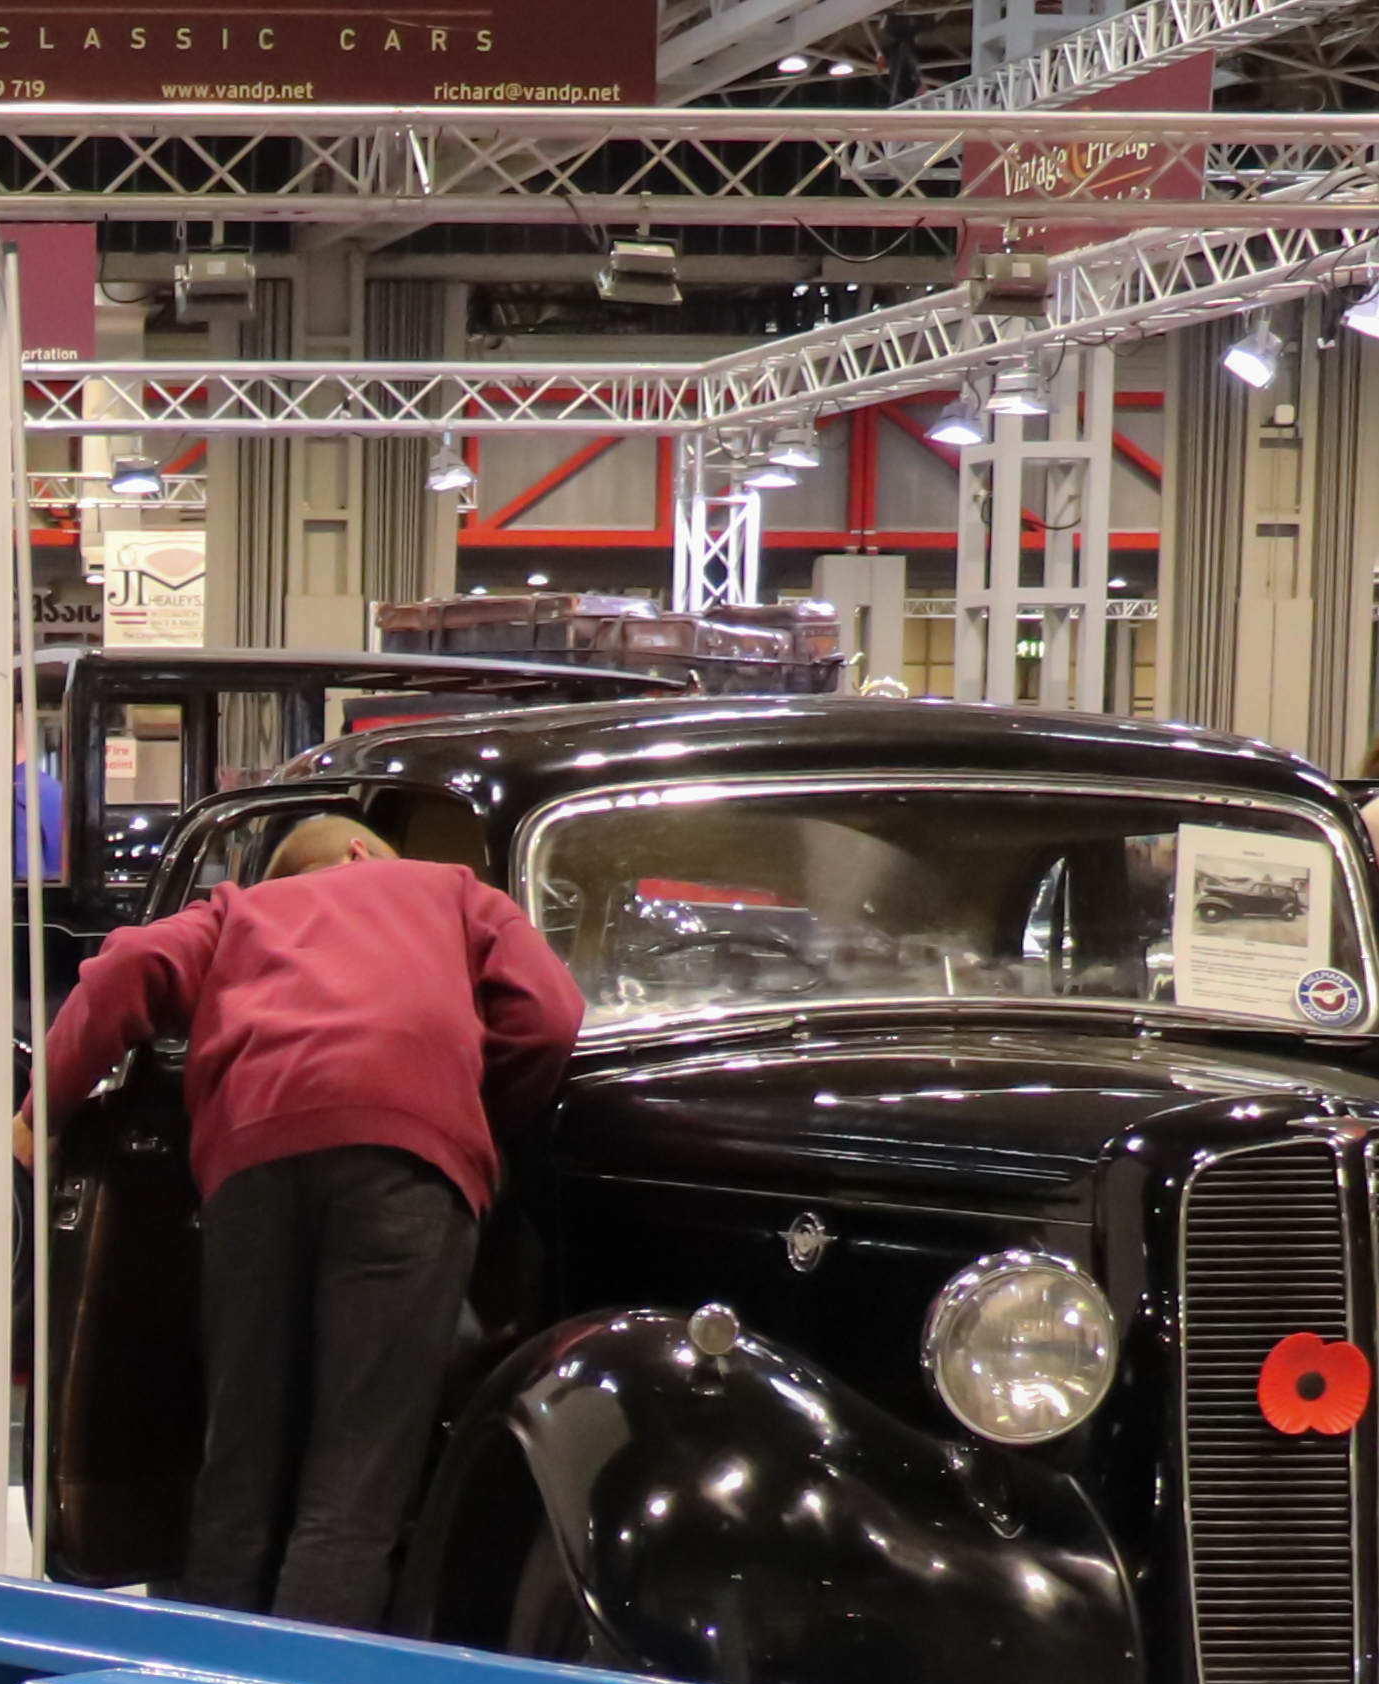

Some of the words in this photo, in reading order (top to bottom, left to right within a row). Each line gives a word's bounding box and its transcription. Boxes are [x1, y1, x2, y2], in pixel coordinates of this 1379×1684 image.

[340, 29, 492, 51] CARS
[11, 80, 45, 97] 719
[162, 82, 313, 101] www.vandp.net
[434, 83, 620, 103] richard@vandp.net
